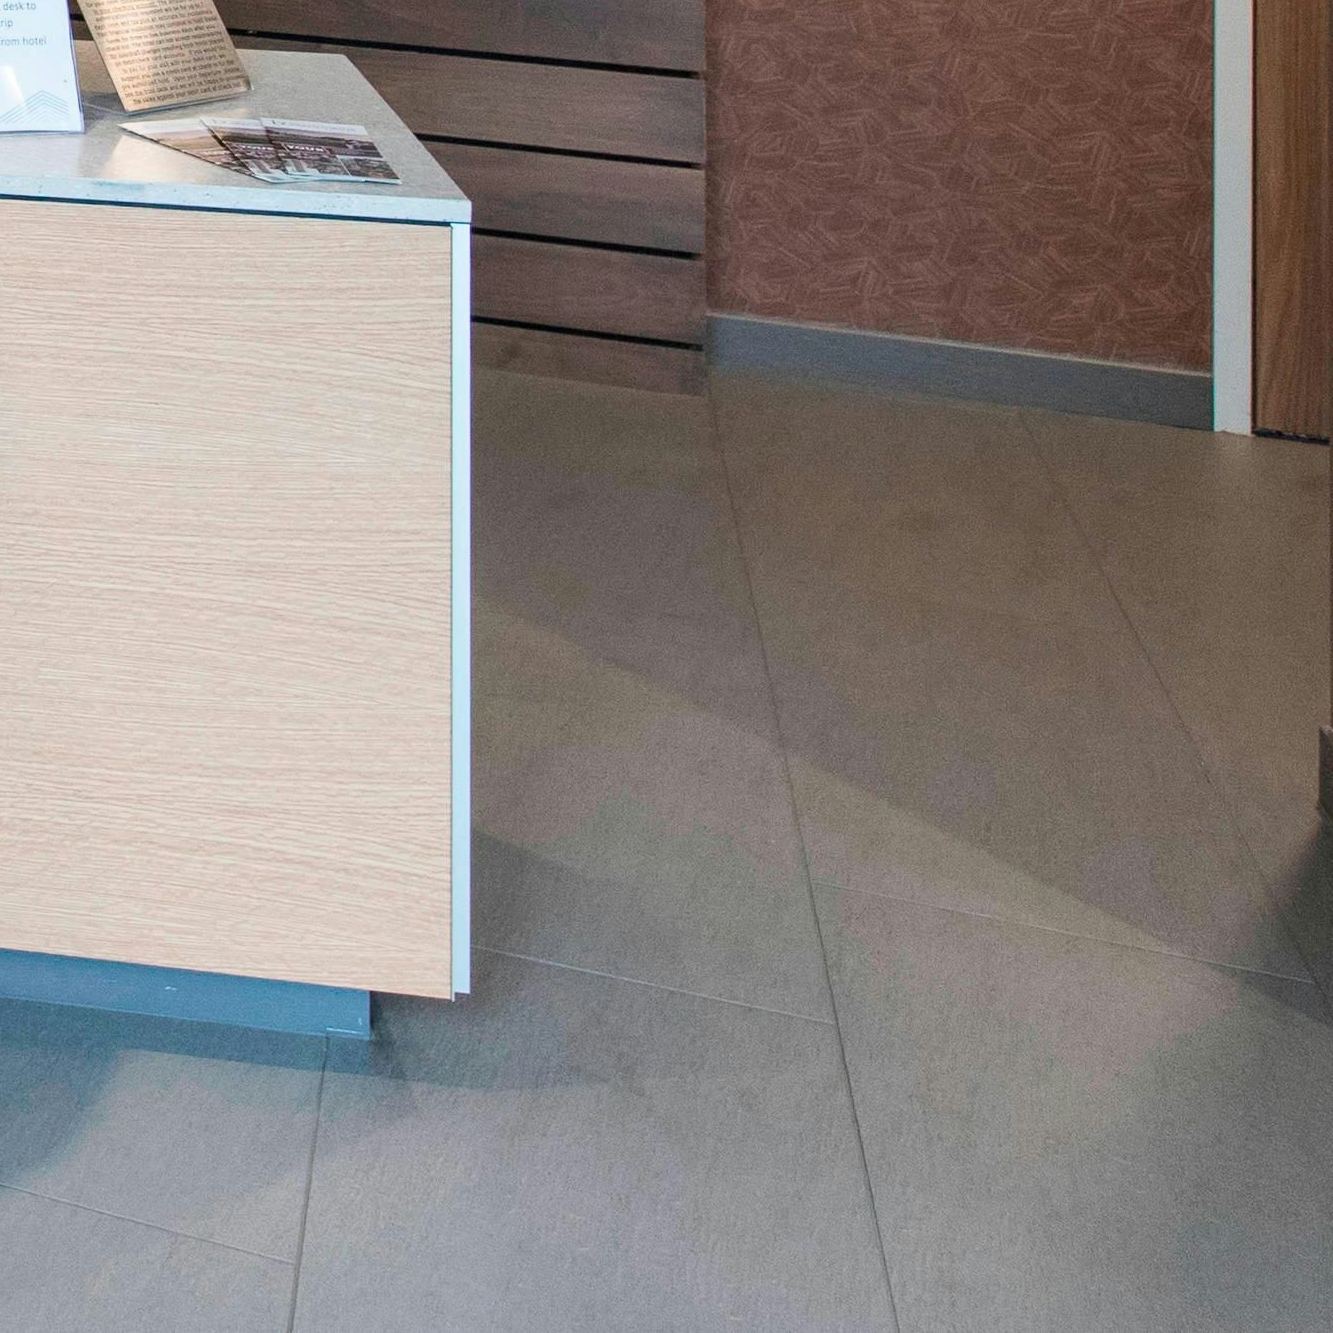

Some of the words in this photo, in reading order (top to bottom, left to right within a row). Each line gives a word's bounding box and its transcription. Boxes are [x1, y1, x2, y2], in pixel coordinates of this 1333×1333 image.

[2, 1, 24, 11] desk
[26, 2, 37, 11] to
[22, 35, 47, 46] hotel
